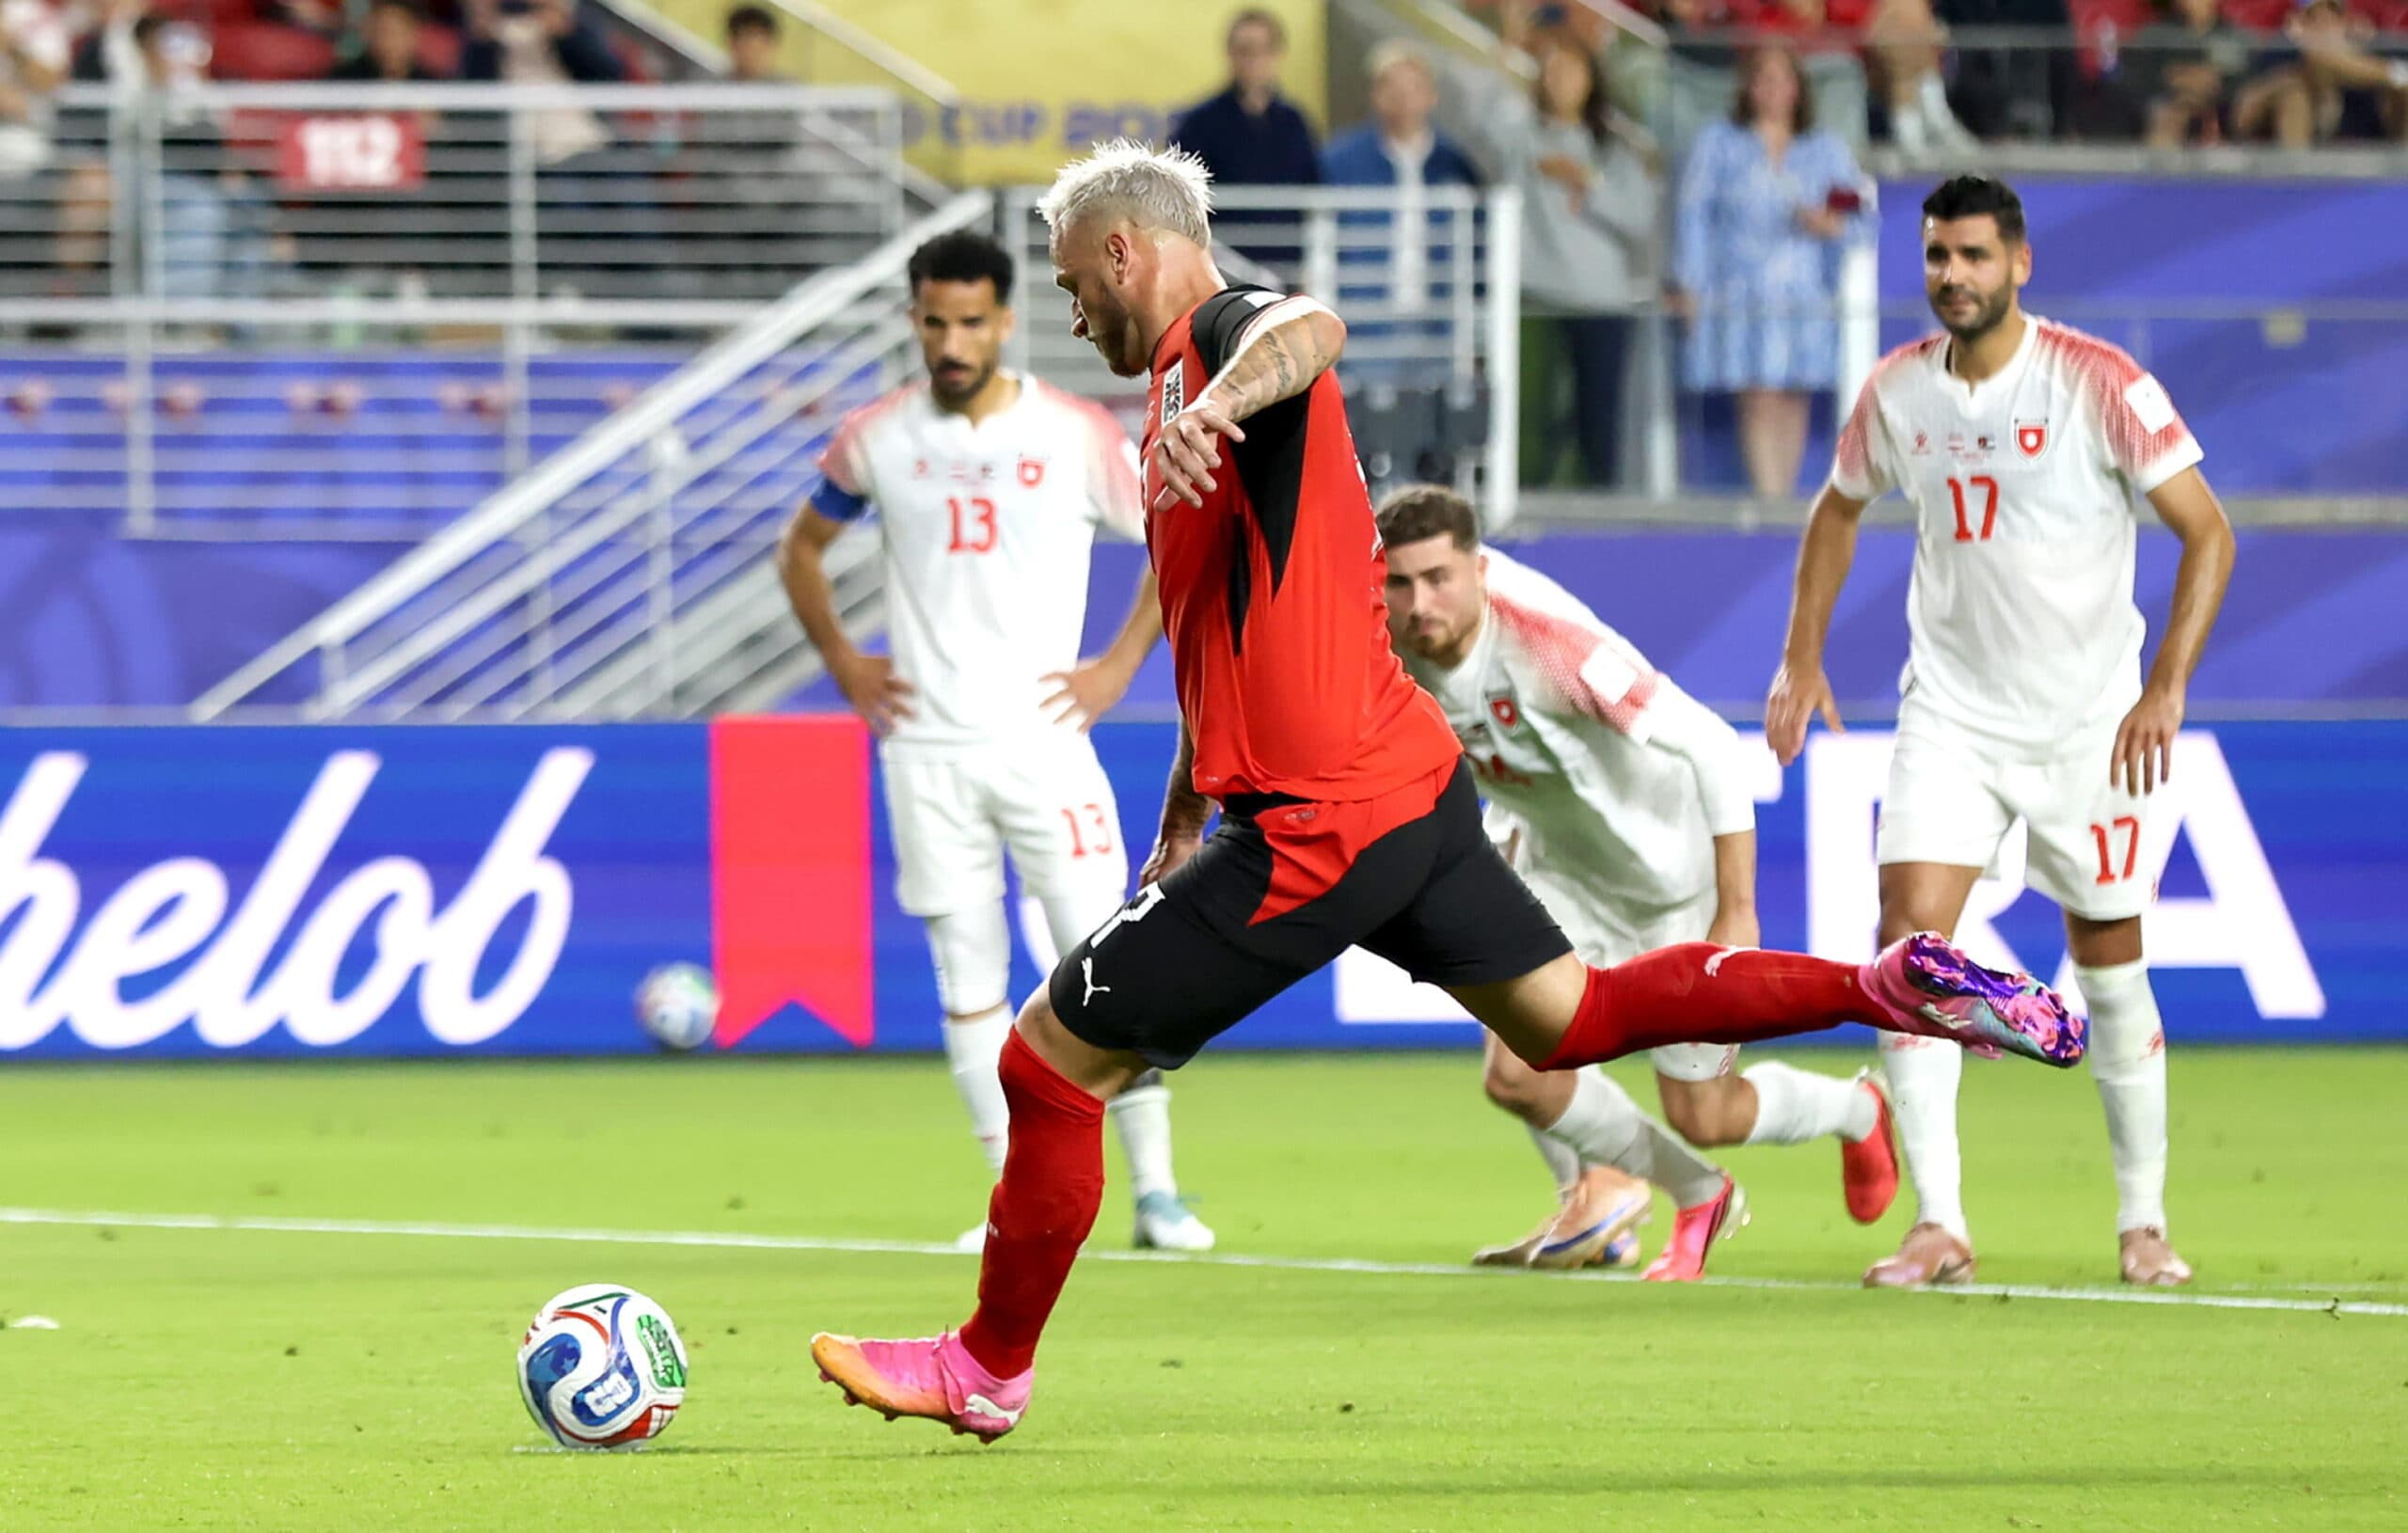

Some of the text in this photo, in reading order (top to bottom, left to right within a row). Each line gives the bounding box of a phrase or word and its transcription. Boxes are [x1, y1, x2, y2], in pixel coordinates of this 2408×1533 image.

[945, 496, 998, 555] 13
[1946, 475, 1999, 543] 17
[1060, 802, 1113, 859] 13
[2089, 814, 2140, 886] 17
